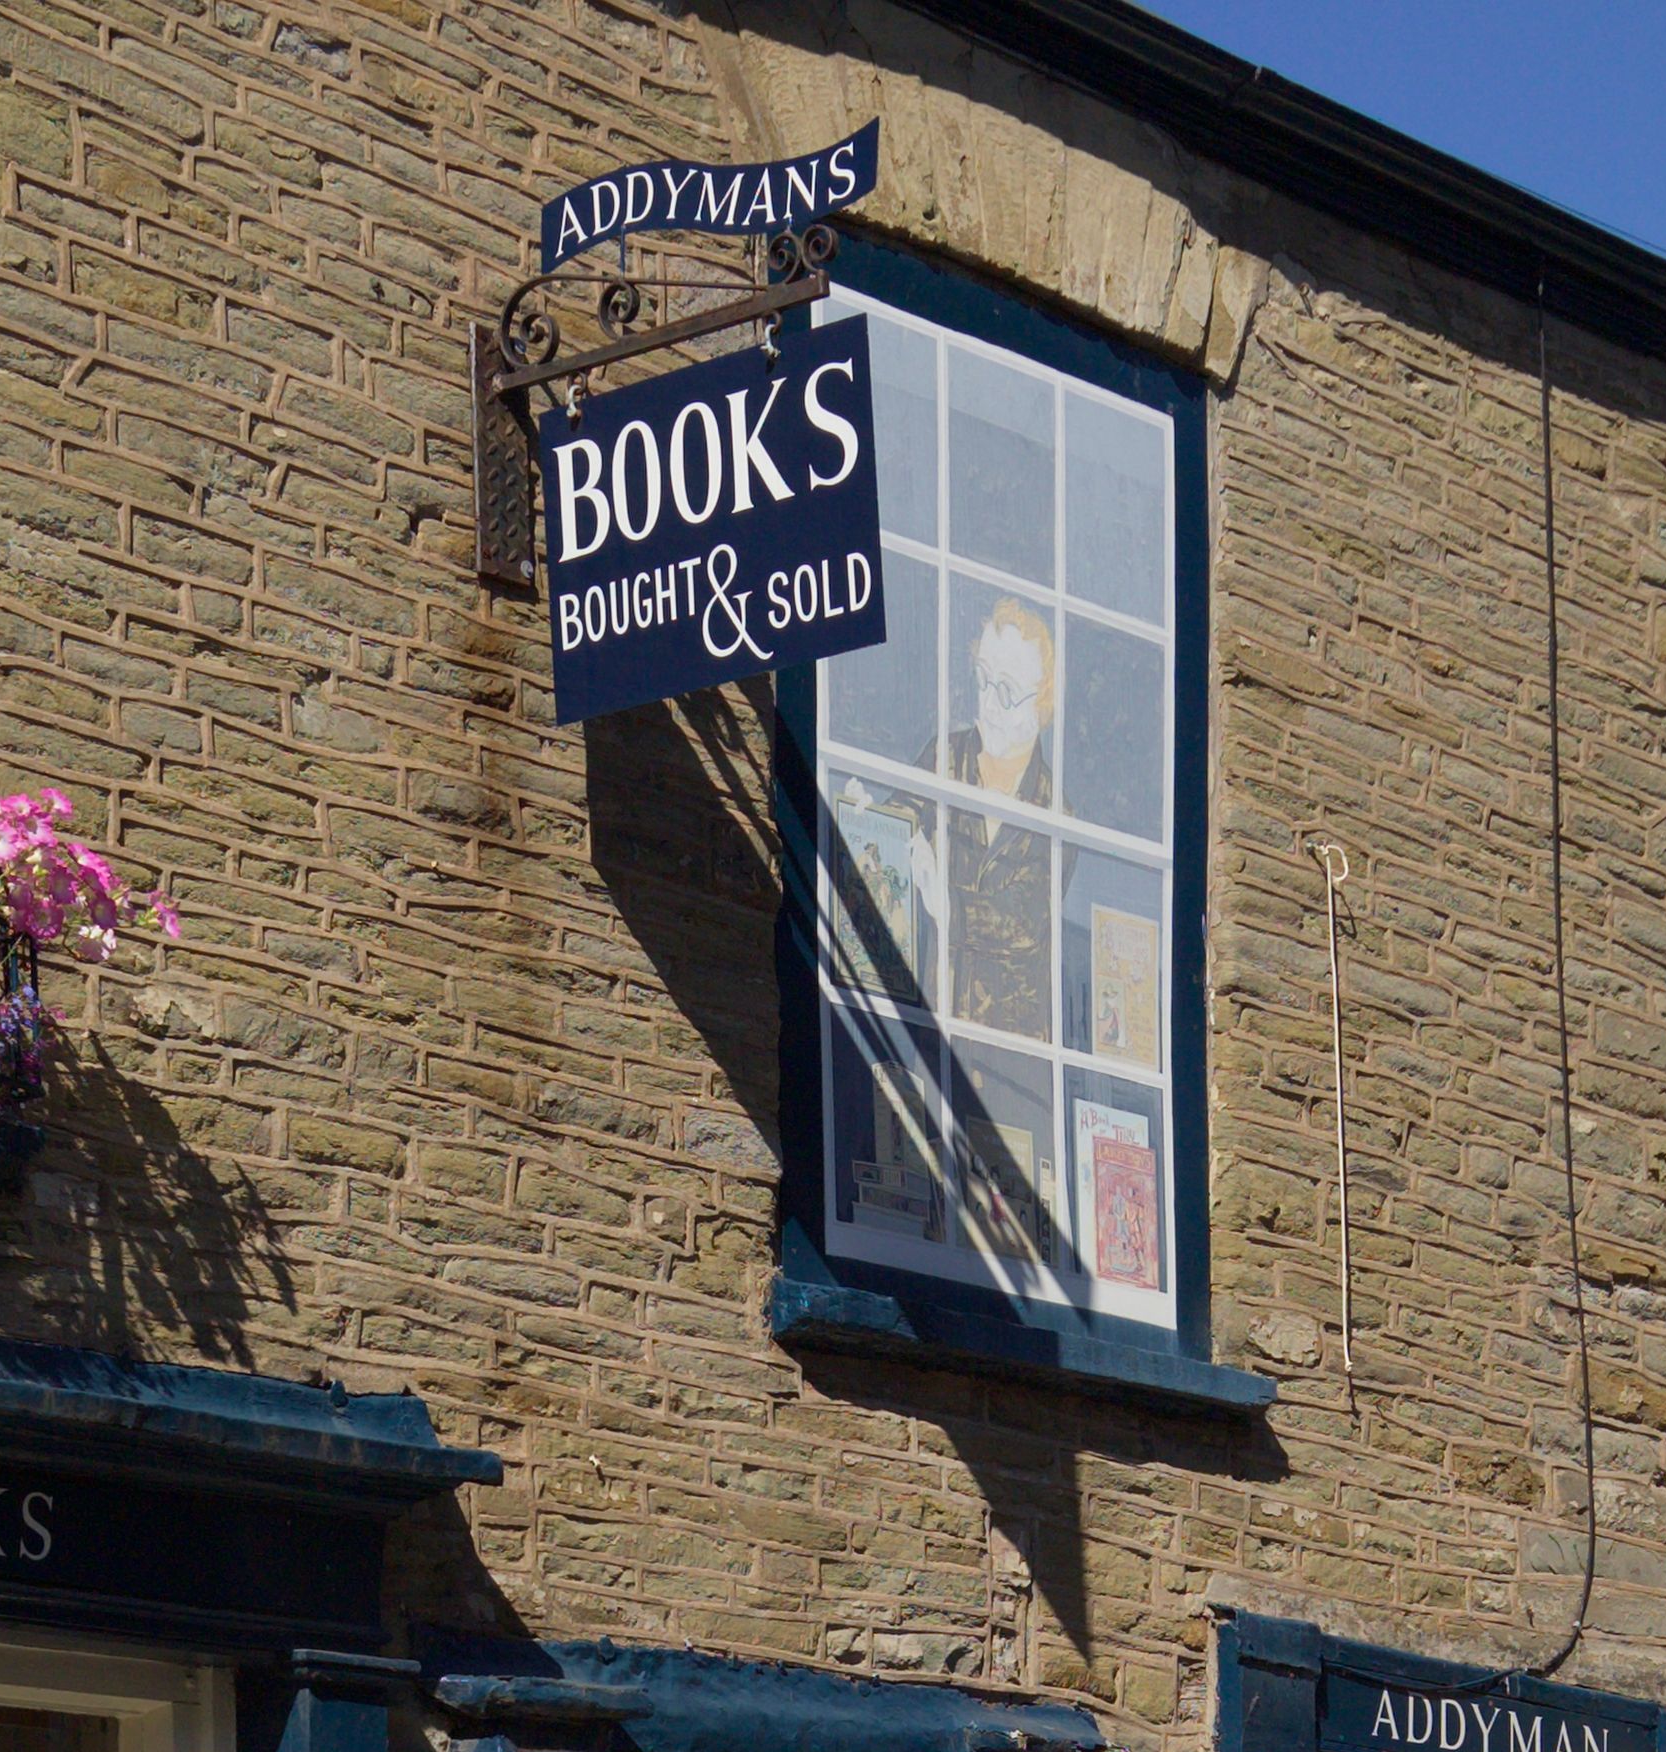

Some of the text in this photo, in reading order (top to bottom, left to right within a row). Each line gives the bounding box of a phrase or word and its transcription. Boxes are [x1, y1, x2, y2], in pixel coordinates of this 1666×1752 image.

[555, 140, 858, 258] ADDYMANS
[551, 357, 860, 564] BOOKS
[559, 543, 873, 660] BOUGHT & SOLD
